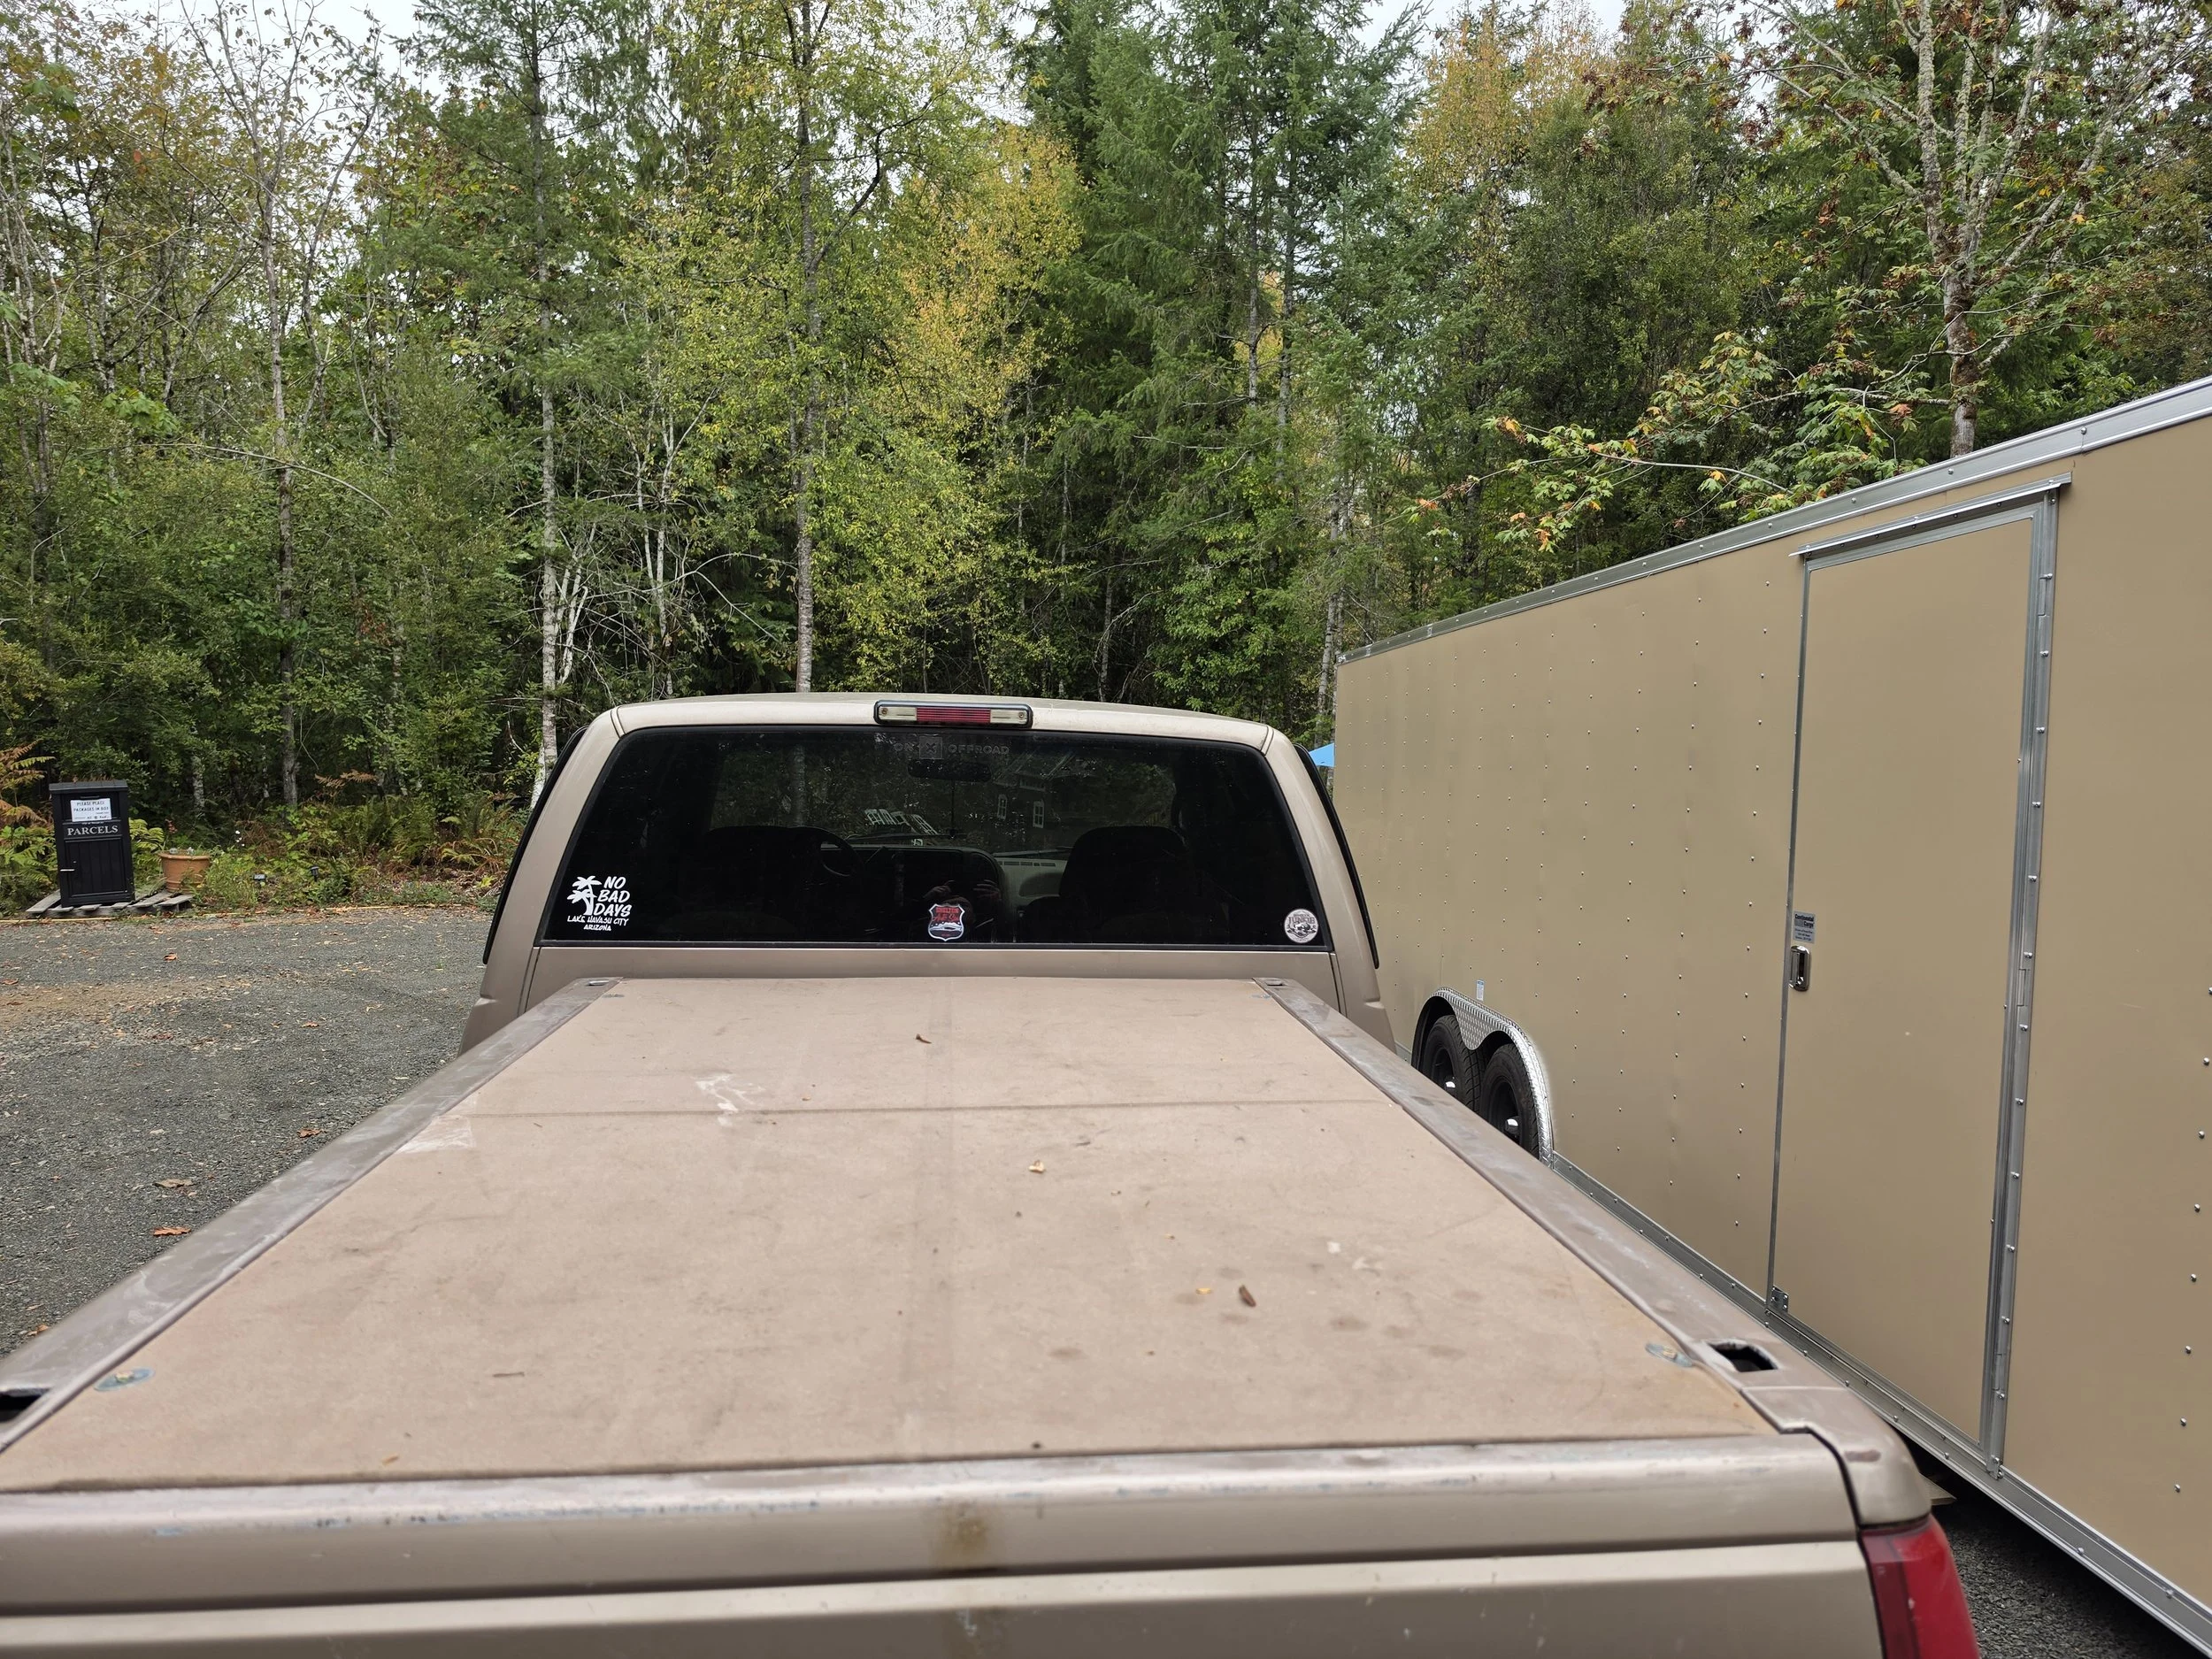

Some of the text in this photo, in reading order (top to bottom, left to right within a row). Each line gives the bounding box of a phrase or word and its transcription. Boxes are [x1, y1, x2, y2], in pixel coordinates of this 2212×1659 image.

[948, 743, 1010, 755] OFFROAD
[67, 825, 119, 836] PARCELS
[603, 876, 626, 889] NO
[597, 889, 630, 902] BAD
[594, 902, 633, 918] DAYS
[587, 916, 612, 925] HAVASU
[613, 918, 629, 926] CITY
